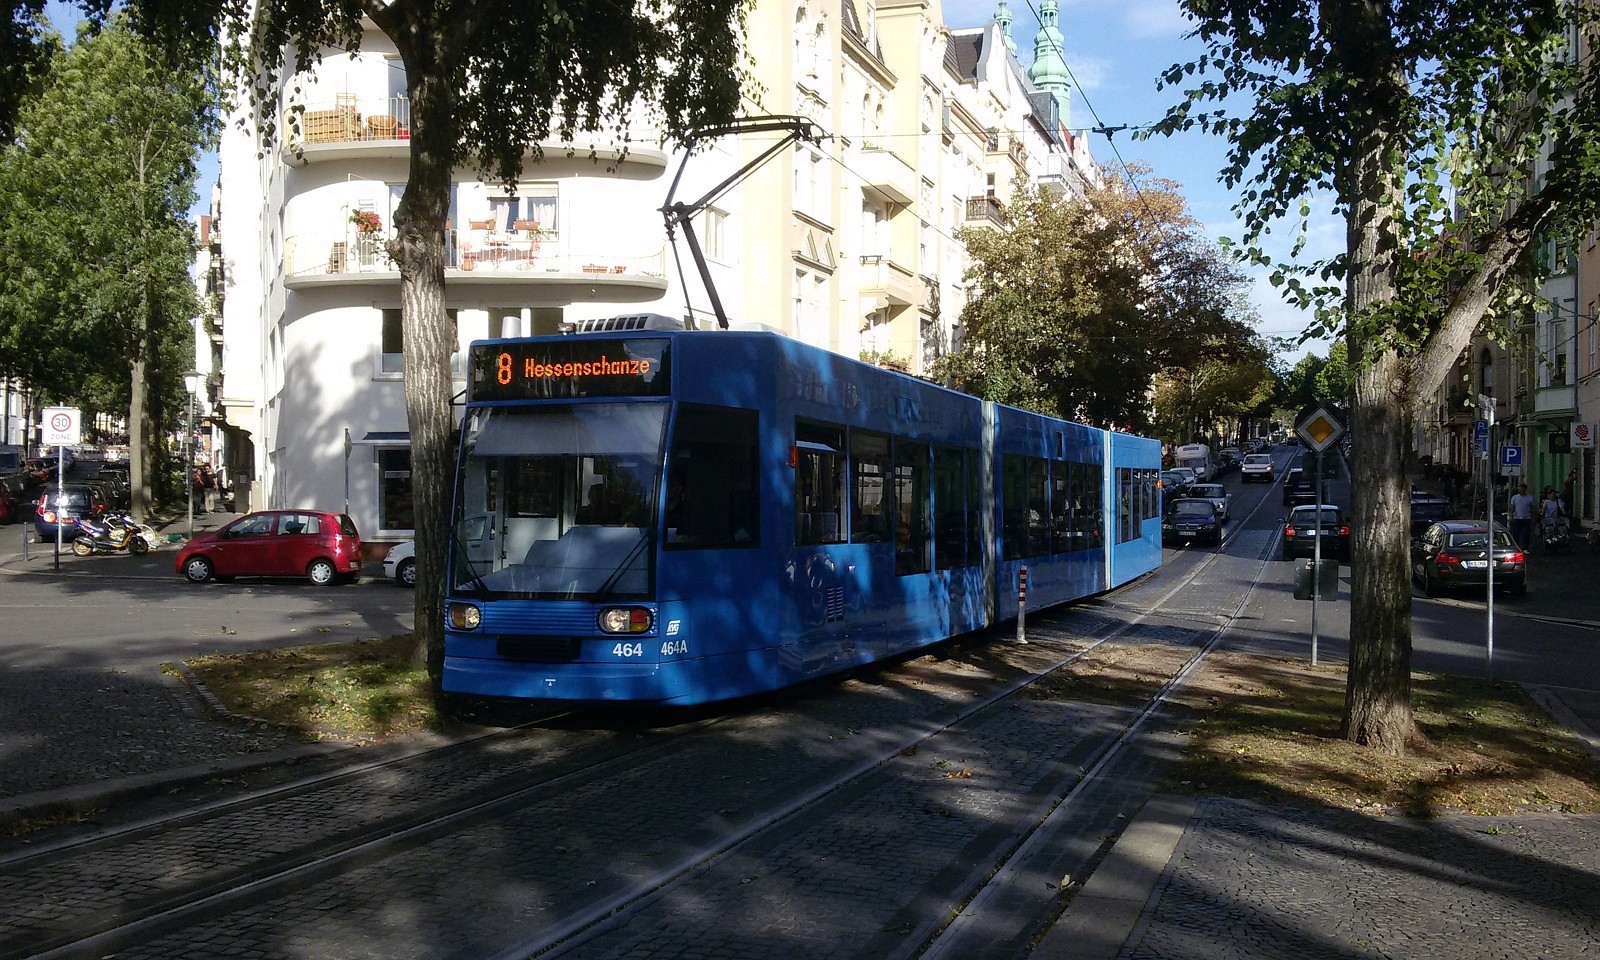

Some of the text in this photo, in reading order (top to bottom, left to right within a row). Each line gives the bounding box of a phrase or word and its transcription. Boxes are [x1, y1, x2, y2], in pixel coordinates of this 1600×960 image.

[497, 352, 650, 385] 8 Hessenschanze
[54, 417, 68, 428] 30
[50, 433, 72, 441] ZONE
[1506, 448, 1518, 463] P
[612, 642, 643, 657] 464
[661, 640, 688, 656] 464A
